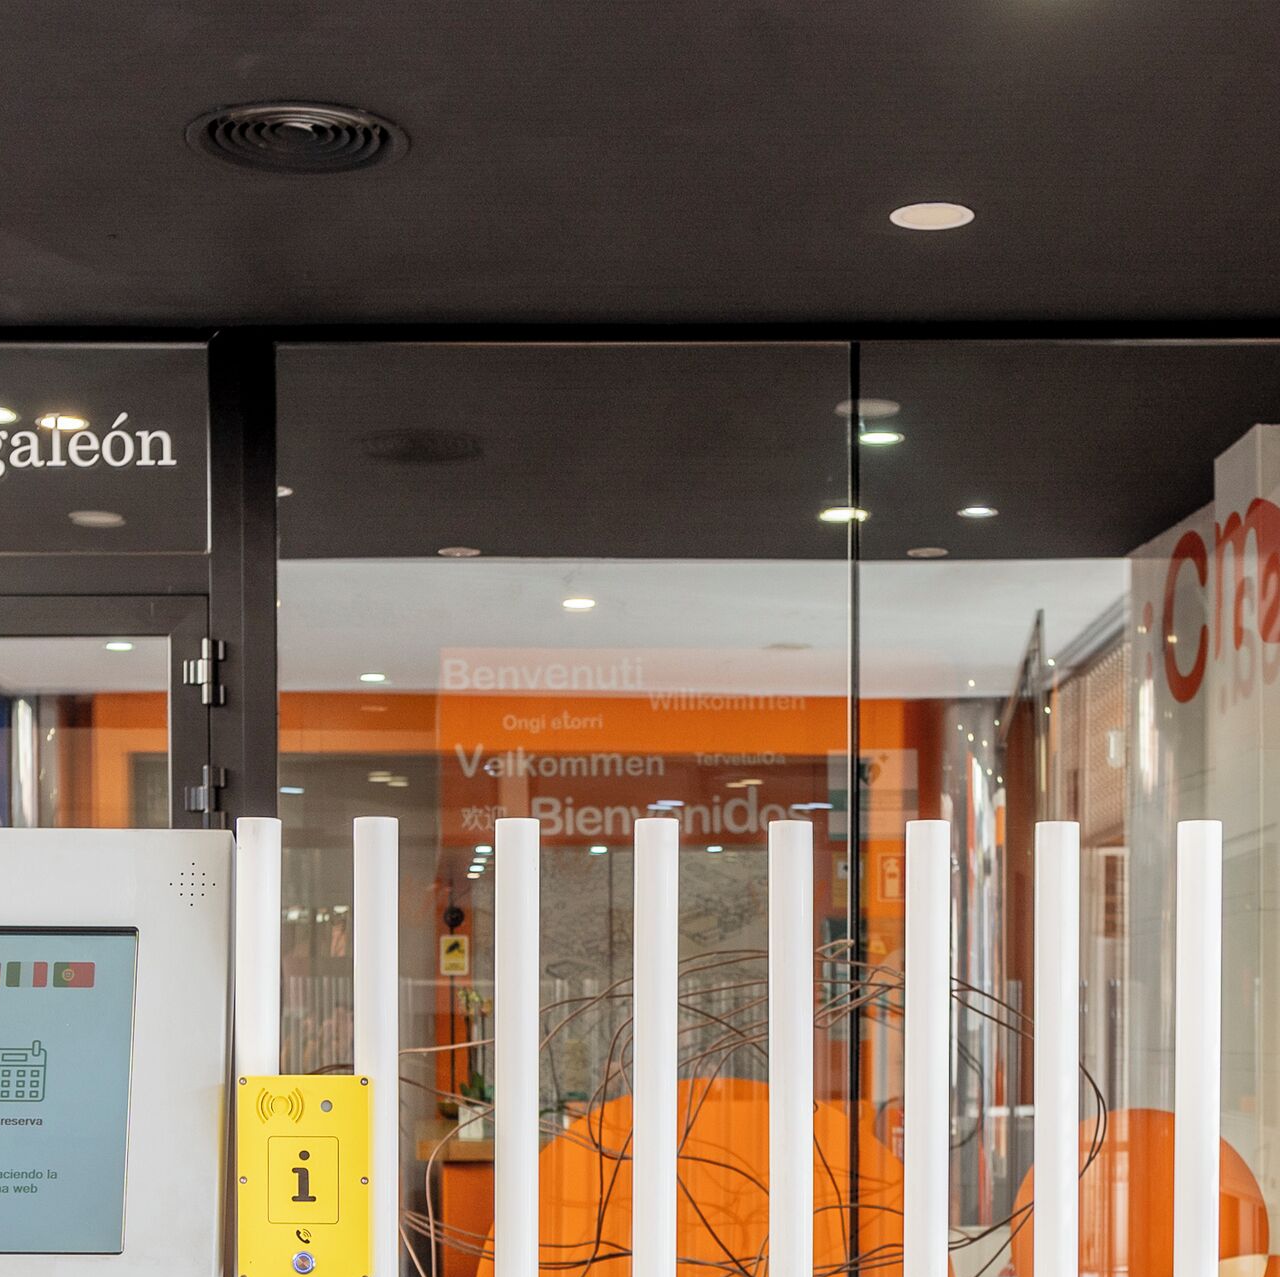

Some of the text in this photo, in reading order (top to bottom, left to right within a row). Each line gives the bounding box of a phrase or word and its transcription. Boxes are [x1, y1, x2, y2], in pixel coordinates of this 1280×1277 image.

[442, 657, 644, 690] Benvenuti
[649, 688, 806, 711] Willkommen
[502, 714, 546, 734] Ongi
[454, 743, 665, 778] Velkommen
[0, 1117, 43, 1126] reserva
[47, 1169, 58, 1180] la
[13, 1183, 38, 1194] web
